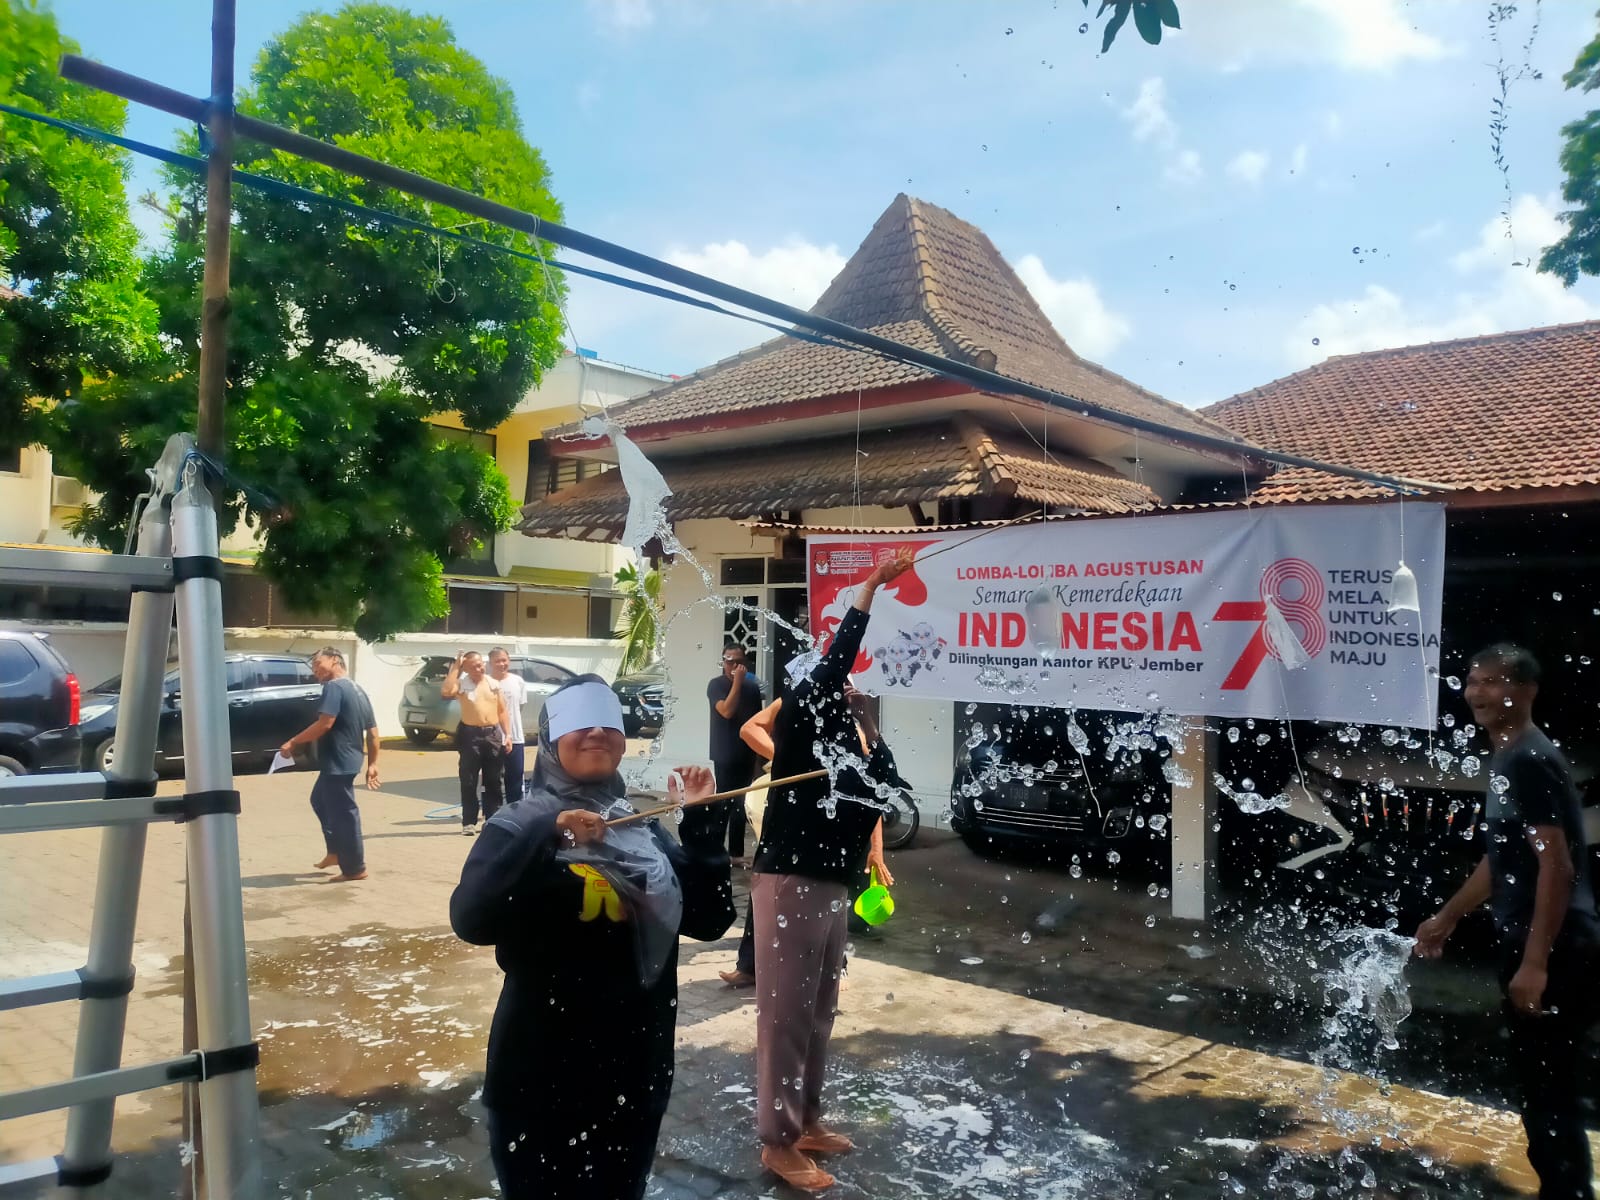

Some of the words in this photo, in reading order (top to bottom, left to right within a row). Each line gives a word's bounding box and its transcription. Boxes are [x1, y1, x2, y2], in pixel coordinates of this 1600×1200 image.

[1084, 559, 1204, 577] AGUSTUSAN
[1328, 569, 1393, 584] TERUS
[972, 586, 1035, 606] Semar
[1052, 579, 1183, 607] Kemerdekaan
[1328, 590, 1391, 605] MELA
[1211, 557, 1326, 690] 78
[1329, 609, 1398, 626] UNTUK
[958, 611, 1202, 652] INDNESIA
[1329, 630, 1440, 648] INDONESIA
[949, 652, 1038, 669] Dilingkungan
[1042, 657, 1093, 669] Kantor
[1097, 656, 1133, 670] KPU
[1139, 657, 1204, 672] Jember
[1330, 650, 1386, 666] MAJU
